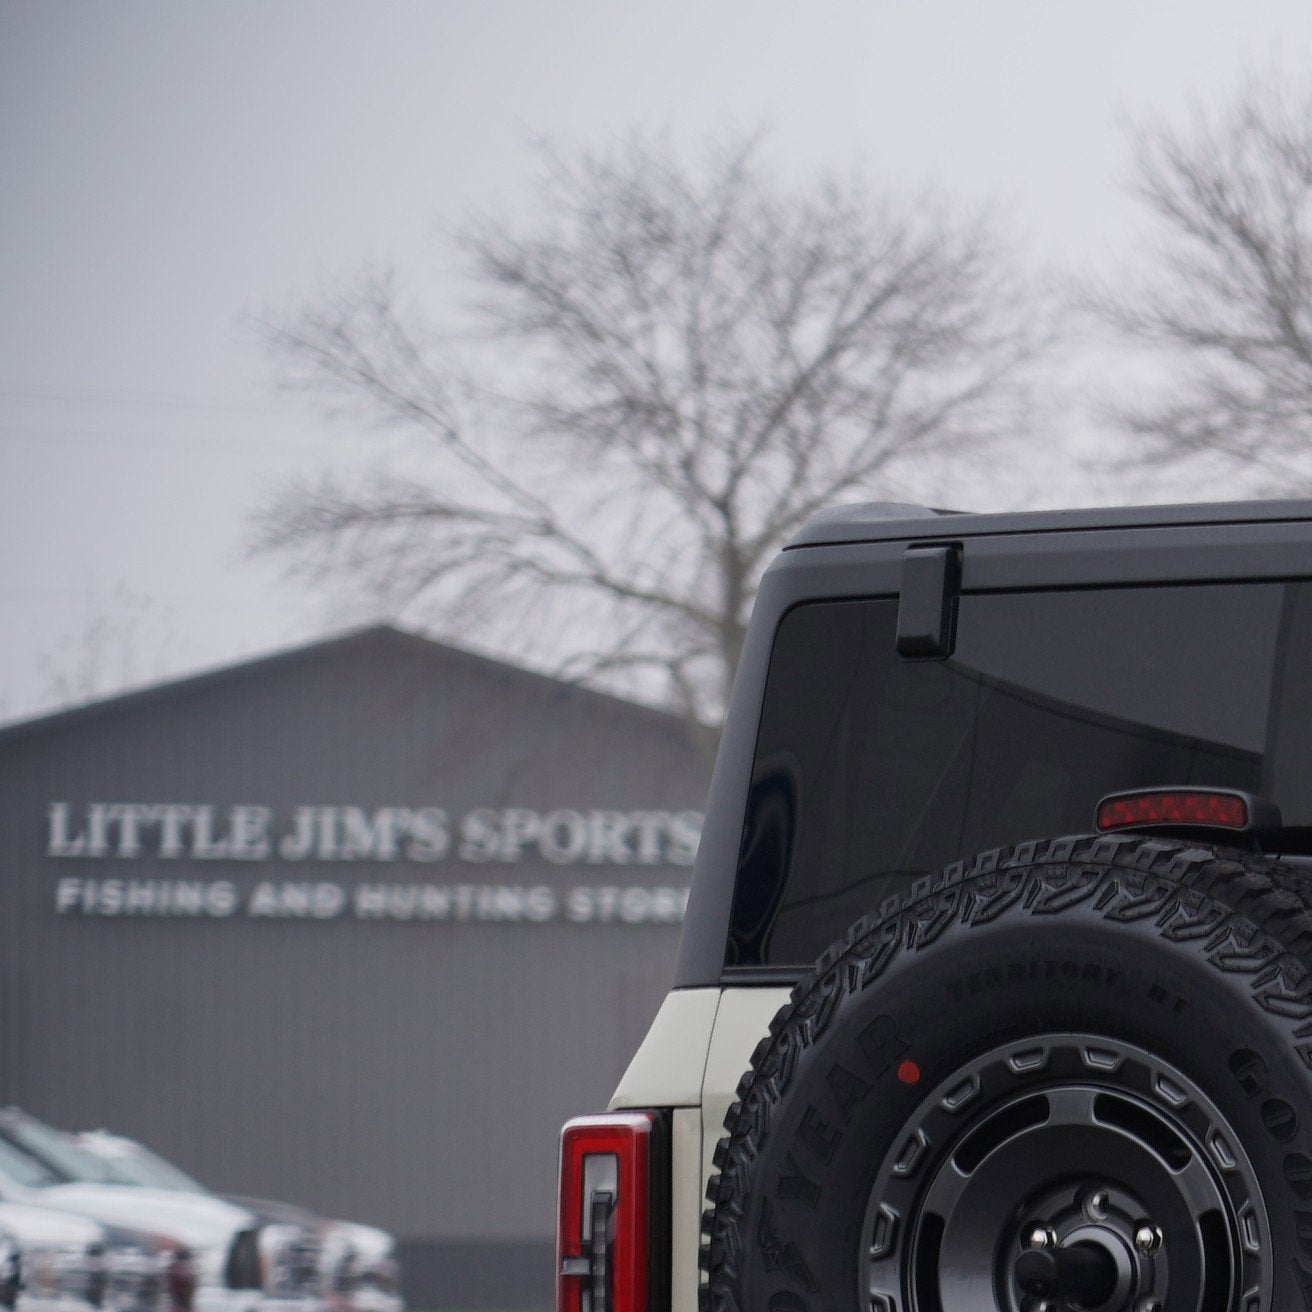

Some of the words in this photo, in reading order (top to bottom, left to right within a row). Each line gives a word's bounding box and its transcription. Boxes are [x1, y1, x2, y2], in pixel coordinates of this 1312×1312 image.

[47, 802, 274, 860] LITTLE
[278, 804, 450, 864] JIM'S
[457, 807, 705, 867] SPORTS
[56, 877, 240, 919] FISHING
[248, 880, 347, 920] AND
[354, 882, 557, 923] HUNTING
[946, 959, 1122, 1002] TERRITORY
